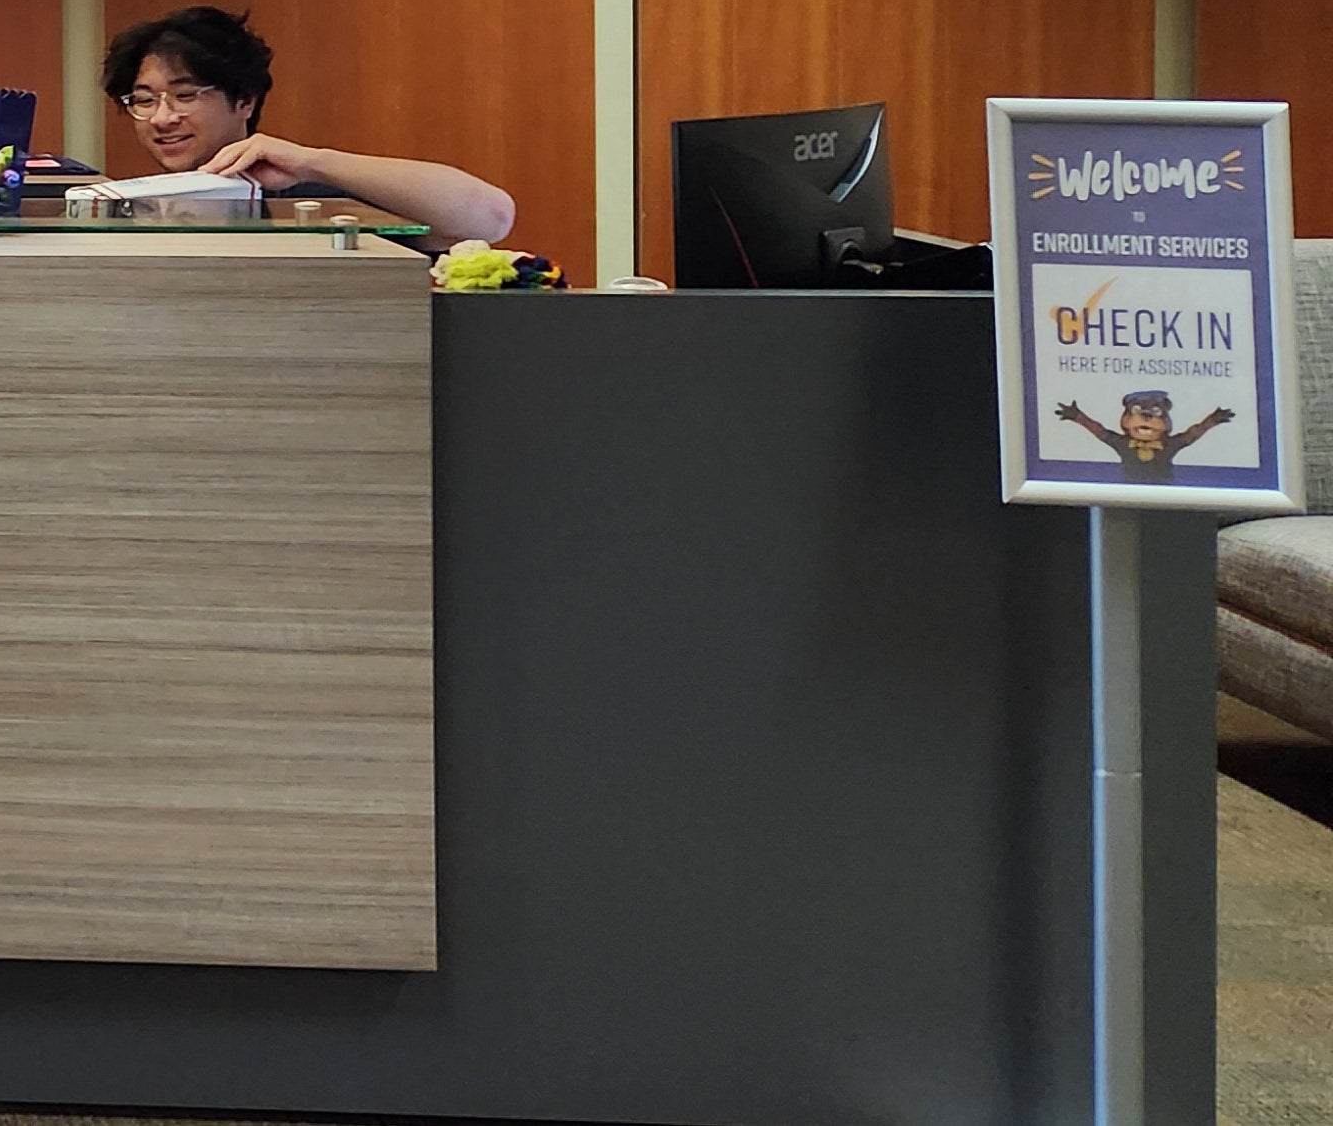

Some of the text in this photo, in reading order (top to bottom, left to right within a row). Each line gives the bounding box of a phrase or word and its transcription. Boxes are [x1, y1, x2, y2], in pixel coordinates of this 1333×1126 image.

[793, 131, 838, 162] acer
[1057, 150, 1222, 202] Welcome
[1033, 232, 1249, 259] ENROLLMENT SERVICES
[1056, 306, 1232, 350] CHECK IN
[1058, 356, 1233, 378] HERE FOR ASSISTANCE
